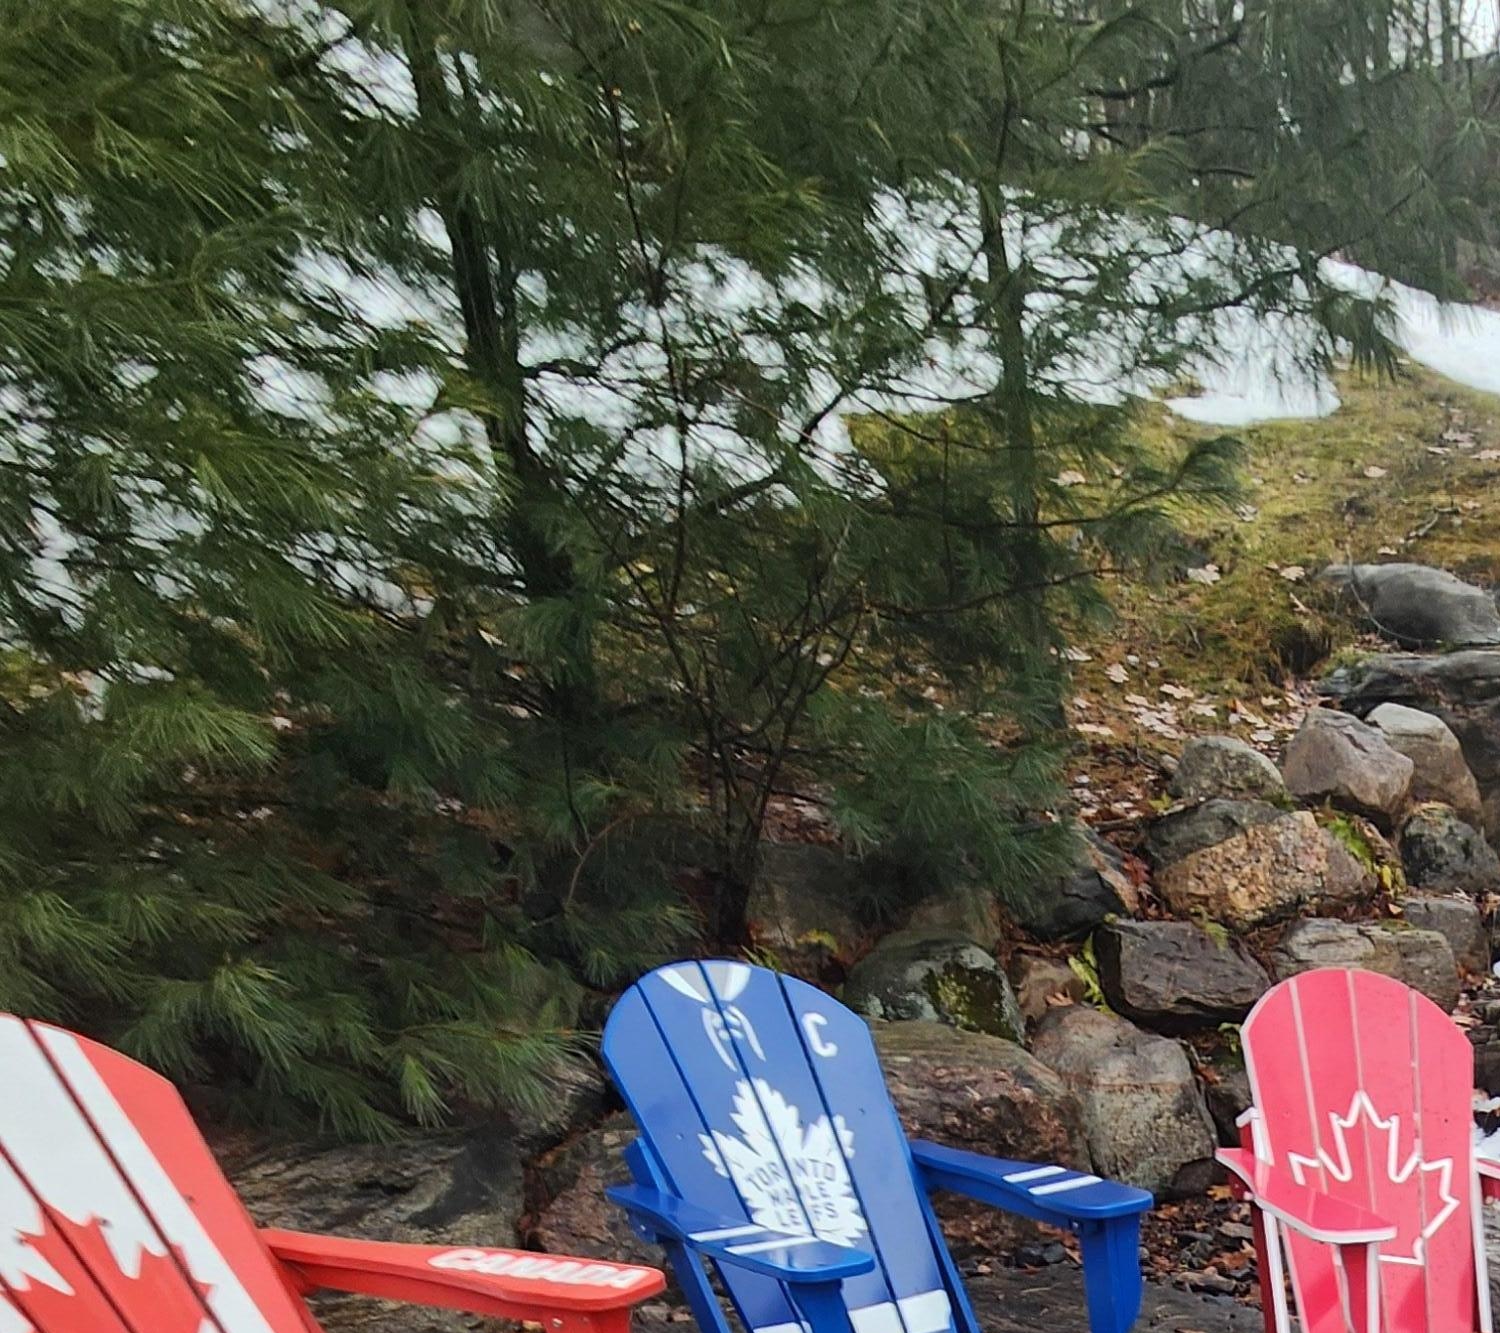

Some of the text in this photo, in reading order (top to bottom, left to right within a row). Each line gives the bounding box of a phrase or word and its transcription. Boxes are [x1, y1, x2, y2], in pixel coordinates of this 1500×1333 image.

[801, 1011, 838, 1057] C
[746, 1157, 836, 1193] TORNTO
[767, 1181, 831, 1207] MALE
[775, 1201, 839, 1228] LEFS
[428, 1248, 650, 1290] CANADA
